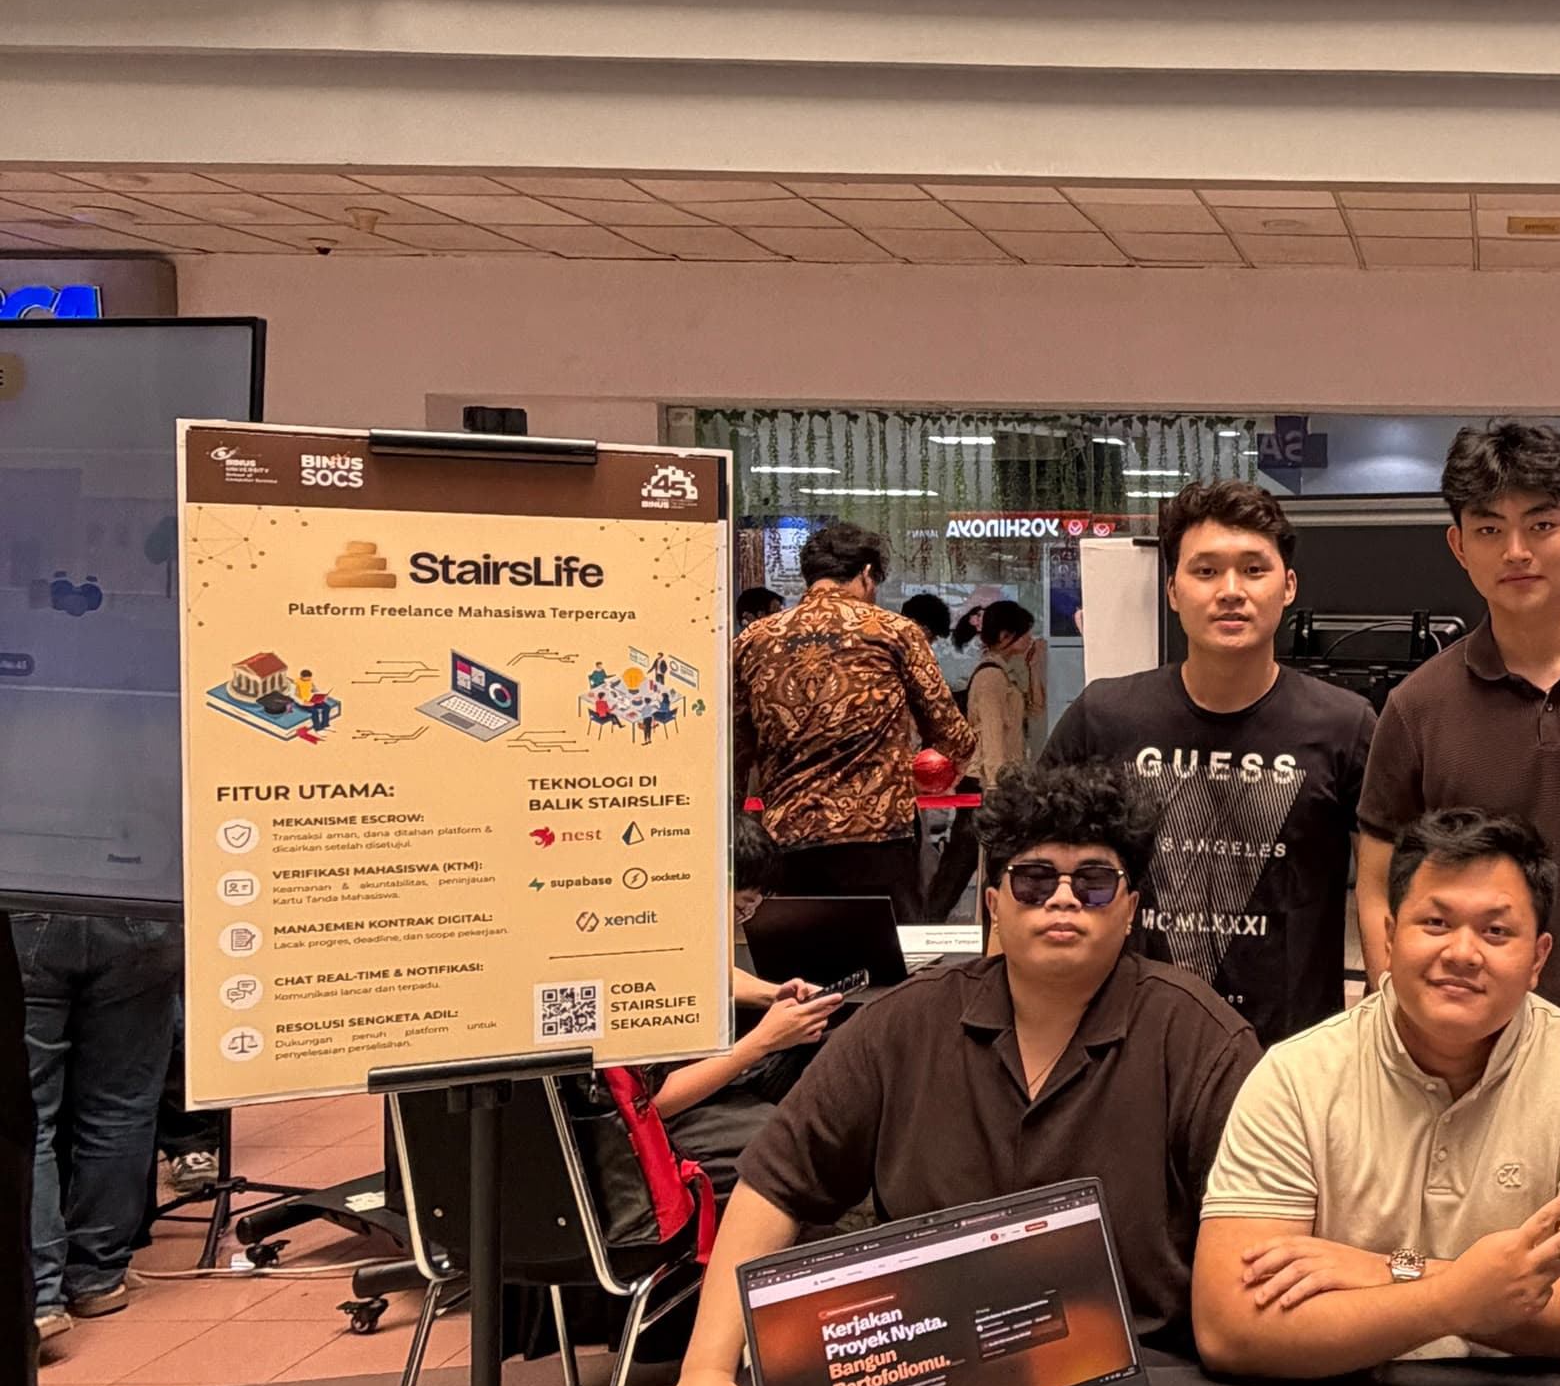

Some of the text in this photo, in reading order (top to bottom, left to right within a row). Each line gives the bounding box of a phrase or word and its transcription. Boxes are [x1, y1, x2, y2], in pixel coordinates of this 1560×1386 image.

[301, 454, 364, 470] BINUS
[301, 469, 364, 488] SOCS
[409, 551, 604, 589] StairsLife
[288, 603, 636, 622] Platform Freelance Mahasiswa Terpercaya
[1136, 747, 1297, 784] GUESS
[528, 775, 657, 791] TEKNOLOGI DI
[216, 782, 395, 802] FITUR UTAMA:
[528, 794, 690, 812] BALIK STAIRSLIFE:
[272, 813, 424, 827] MEKANISME ESCROW:
[272, 831, 322, 842] Transaksi
[363, 829, 390, 839] dana
[394, 827, 434, 837] ditahan
[437, 825, 482, 837] platform
[484, 826, 493, 834] &
[561, 828, 602, 842] nest
[650, 826, 691, 838] Prisma
[272, 843, 322, 854] dicairkan
[325, 841, 363, 851] setelah
[272, 861, 483, 880] VERIFIKASI MAHASISWA (KTM):
[650, 871, 691, 883] socket.io
[272, 883, 332, 894] Keamanan
[438, 875, 496, 888] peninjauan
[550, 875, 613, 890] supabase
[272, 895, 303, 906] Kartu
[306, 893, 339, 904] Tanda
[273, 913, 493, 936] MANAJEMEN KONTRAK DIGITAL:
[604, 911, 658, 927] xendit
[273, 939, 305, 950] Lacak
[403, 931, 423, 942] dan
[425, 930, 455, 941] scope
[274, 963, 484, 987] CHAT REAL-TIME & NOTIFIKASI:
[274, 989, 338, 1001] Komunikasi
[340, 985, 372, 996] lancar
[375, 984, 395, 994] dan
[610, 981, 656, 995] COBA
[610, 996, 697, 1013] STAIRSLIFE
[275, 1009, 458, 1034] RESOLUSI SENGKETA ADIL:
[610, 1013, 700, 1030] SEKARANG!
[275, 1020, 497, 1049] Dukungan penuh platform untuk
[275, 1046, 345, 1061] penyelesaian
[822, 1308, 903, 1341] Kerjakan
[825, 1330, 890, 1361] Proyek
[890, 1316, 948, 1342] Nyata.
[828, 1349, 898, 1380] Bangun
